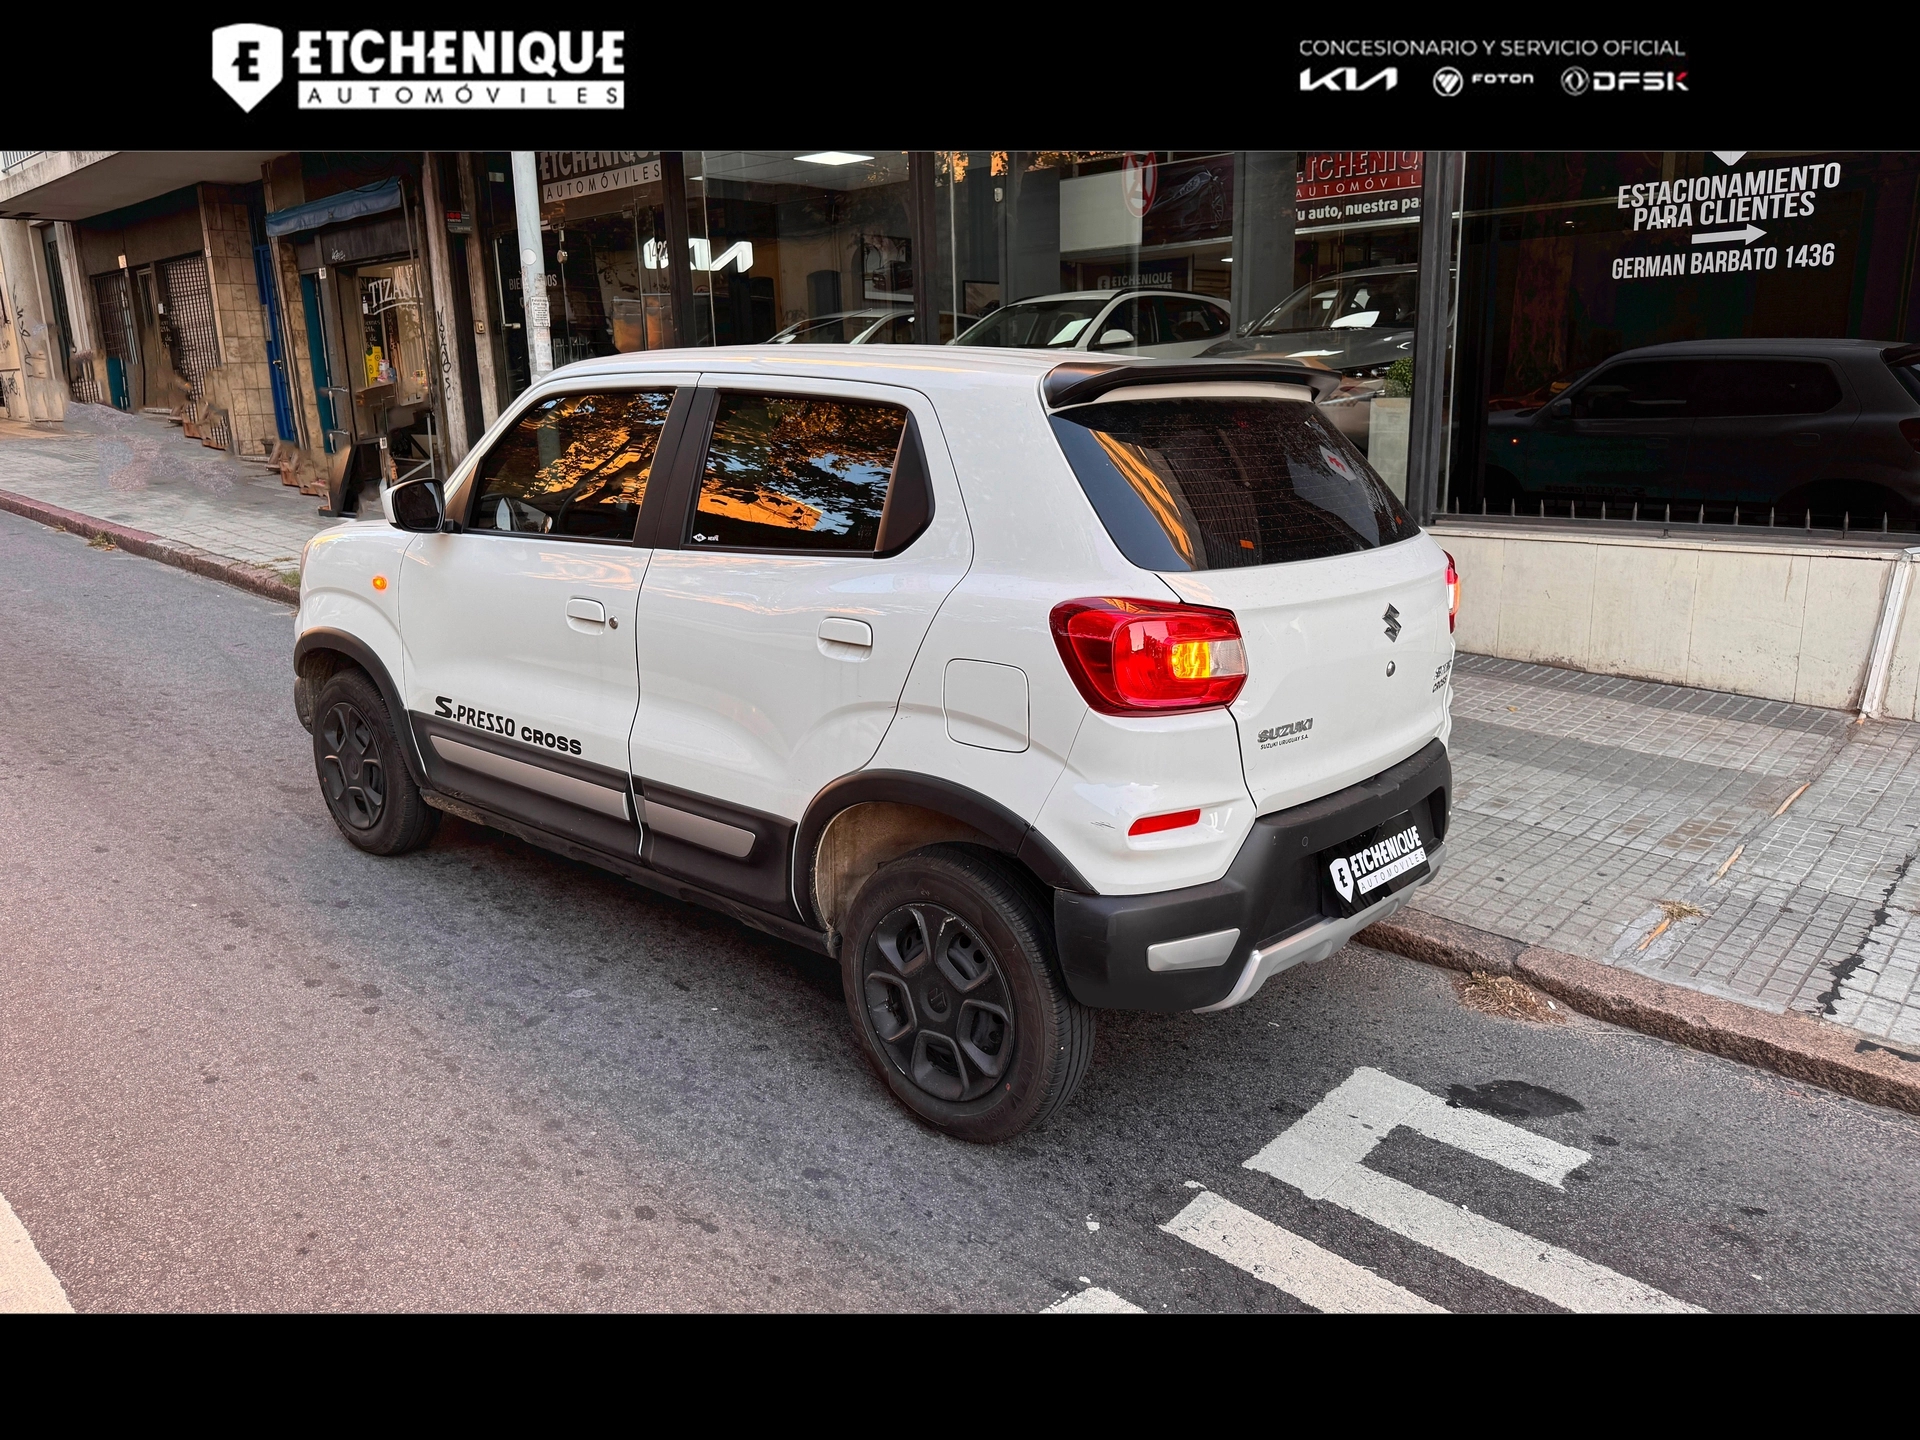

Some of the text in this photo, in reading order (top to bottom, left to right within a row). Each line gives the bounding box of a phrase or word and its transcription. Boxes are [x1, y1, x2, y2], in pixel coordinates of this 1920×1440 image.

[546, 163, 661, 200] AUTOMÓVILES
[1617, 161, 1841, 209] ESTACIONAMIENTO
[1296, 197, 1421, 221] u auto, nuestra pa
[1633, 190, 1816, 232] PARA CLIENTES
[1111, 271, 1173, 287] ETCHENIQUE
[1611, 242, 1836, 280] GERMAN BARBATO 1436
[434, 695, 582, 755] S.PRESSO CROSS
[1257, 717, 1313, 743] SUZUKI
[1260, 741, 1278, 750] SUZUKI
[1349, 825, 1422, 878] ETCHENIQUE
